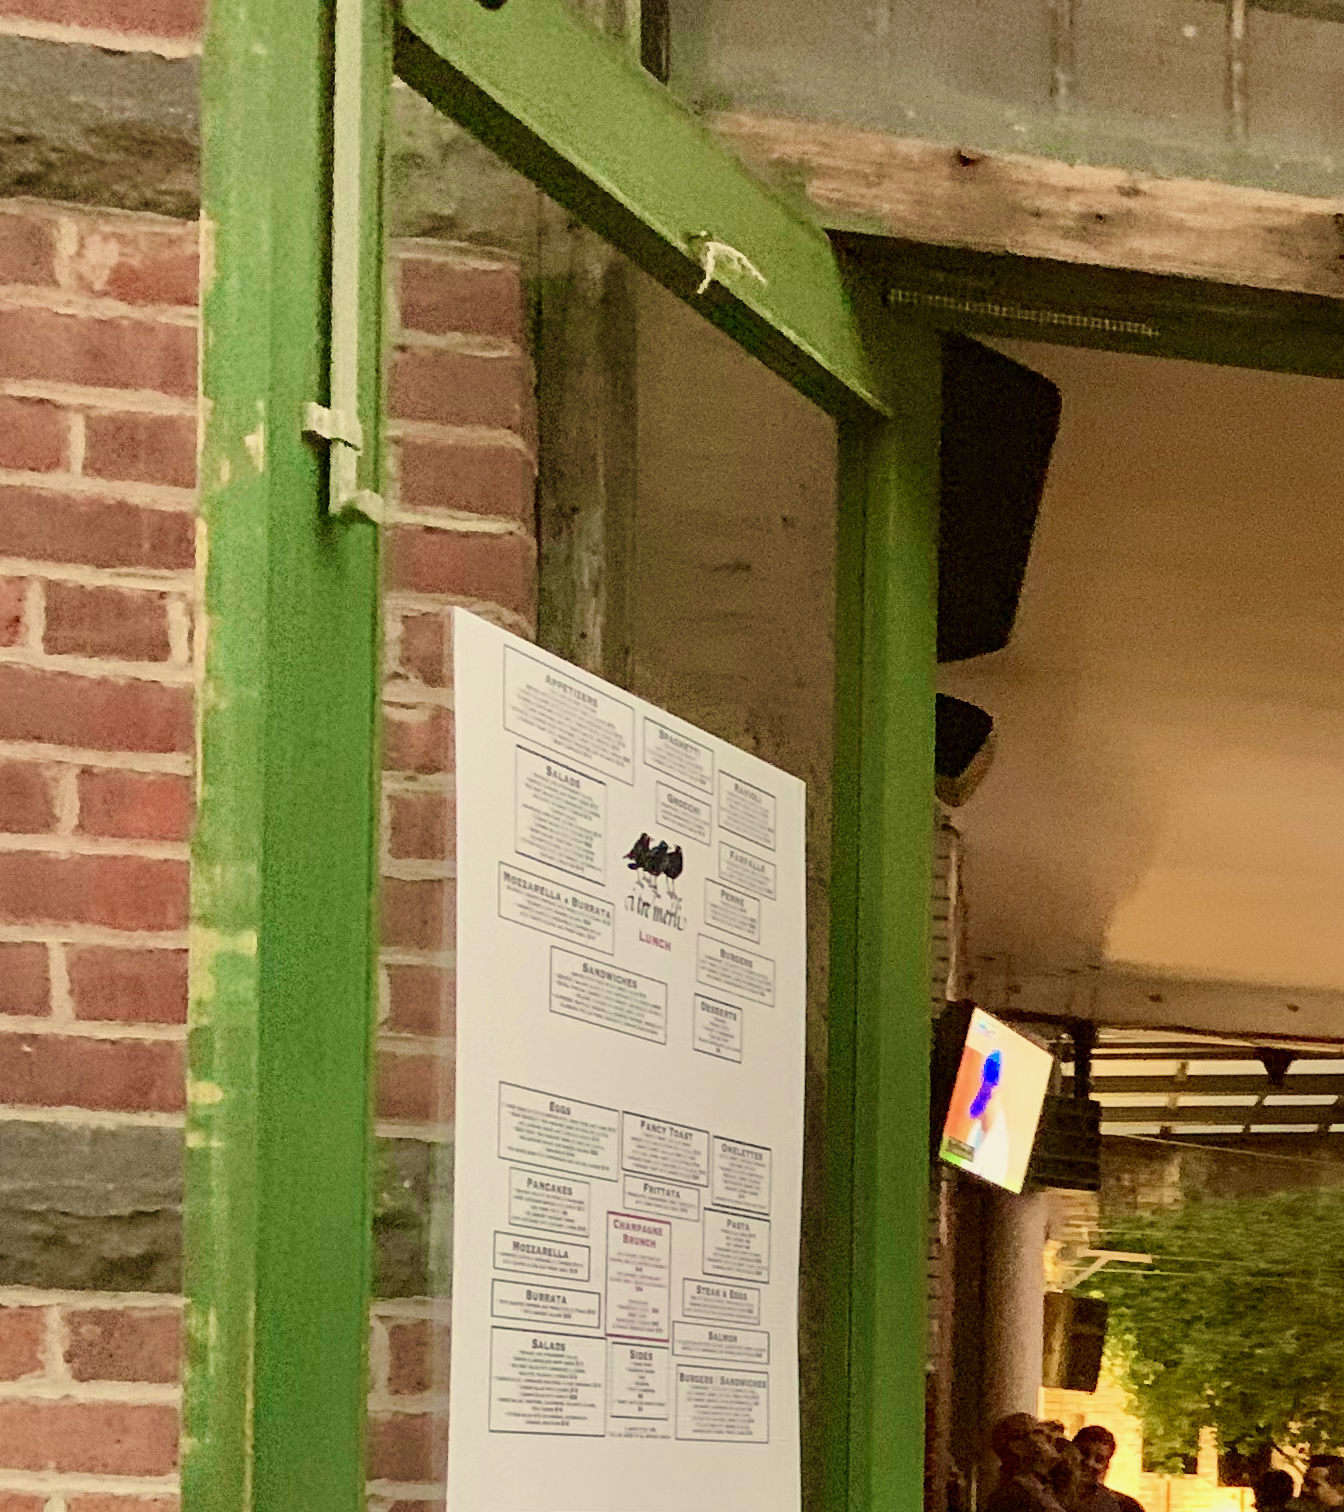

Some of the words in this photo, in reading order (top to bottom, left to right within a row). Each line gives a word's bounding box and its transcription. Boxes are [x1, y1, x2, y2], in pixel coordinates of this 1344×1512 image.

[503, 871, 561, 900] MOZZARELLA
[572, 897, 611, 918] BURRATA
[638, 930, 672, 952] LUNCH
[582, 963, 638, 989] SANDWICHES
[549, 1101, 571, 1116] EGGS
[640, 1120, 667, 1135] FANCY
[669, 1127, 693, 1141] TOAST
[527, 1178, 573, 1196] PANCAKES
[643, 1183, 681, 1199] FRITTATA
[613, 1218, 664, 1237] CHAMPAGNE
[726, 1218, 750, 1231] PASTA
[512, 1240, 569, 1259] MOZZARELLA
[622, 1234, 657, 1249] BRUNCH
[526, 1289, 567, 1305] BURRATA
[532, 1338, 566, 1351] SALADS
[720, 1376, 767, 1389] SANDWICHES
